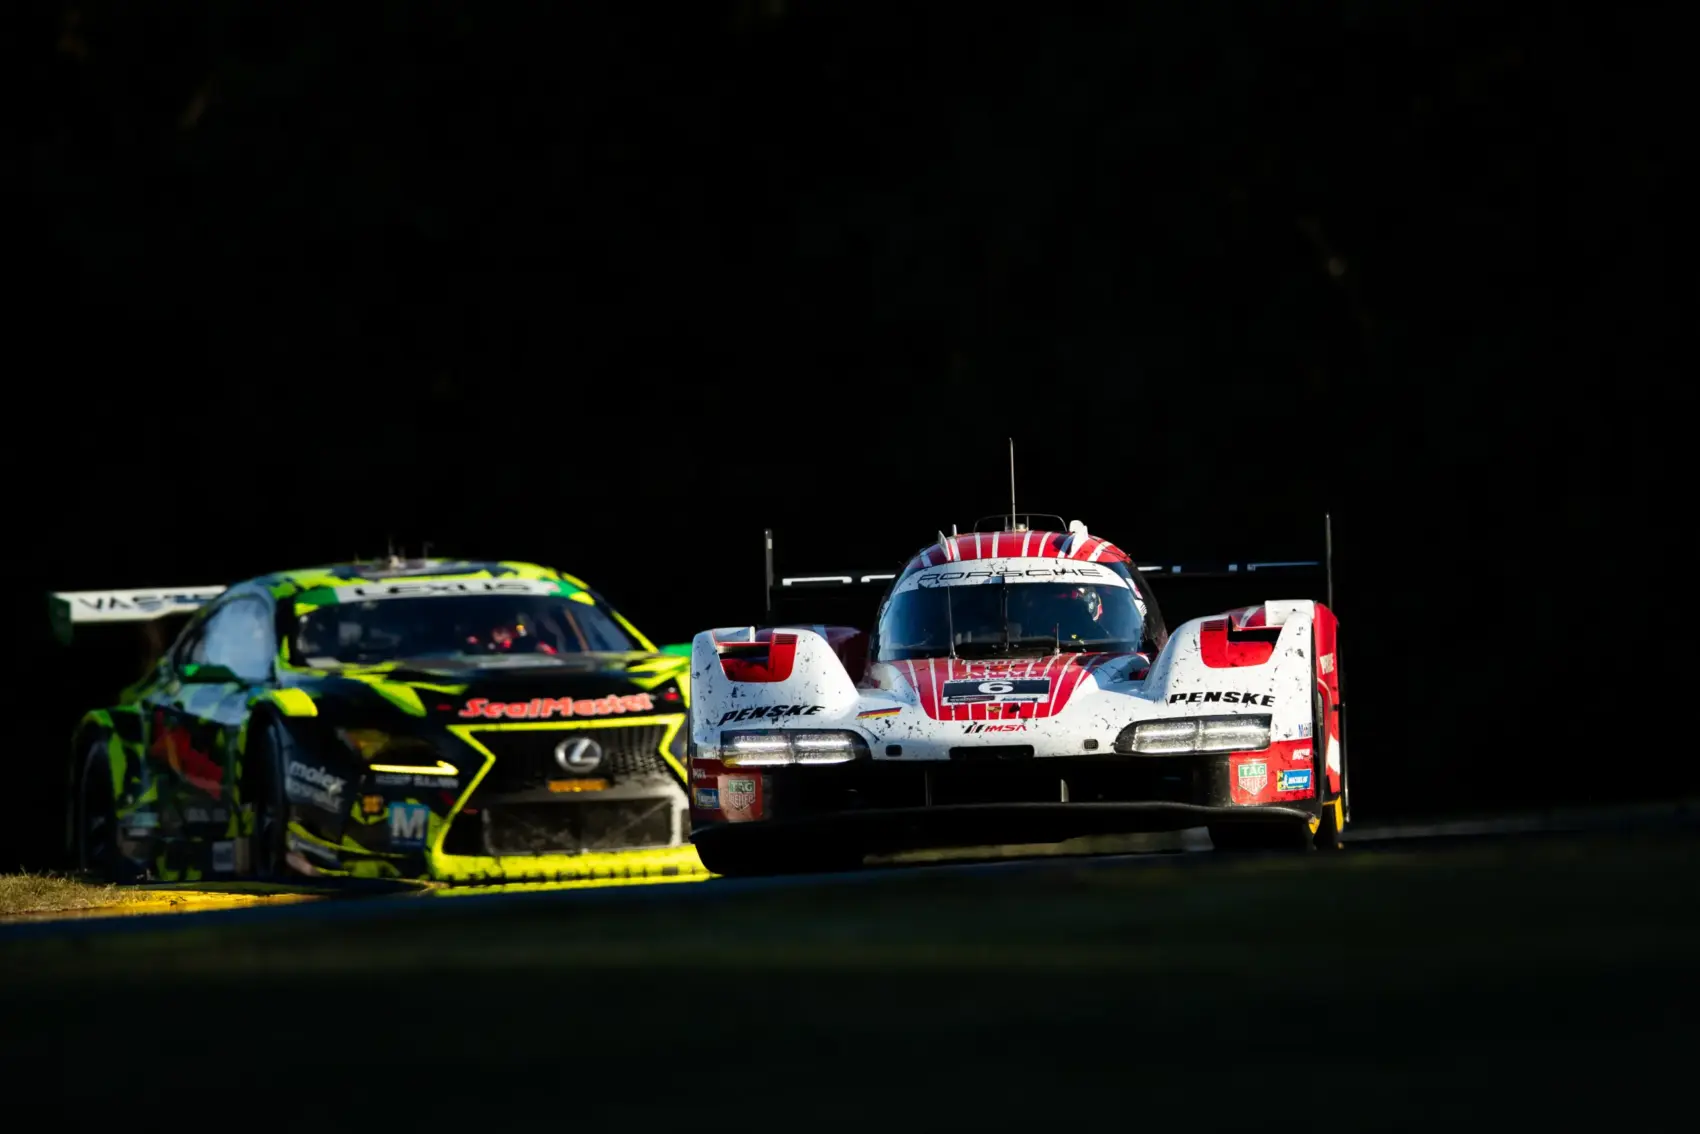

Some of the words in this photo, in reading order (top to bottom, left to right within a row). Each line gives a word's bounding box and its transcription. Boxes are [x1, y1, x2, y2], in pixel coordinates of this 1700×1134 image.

[918, 568, 1103, 586] PORSCHE
[978, 681, 1014, 695] 6
[458, 692, 654, 718] SealMaster
[1168, 690, 1275, 707] PENSKE
[717, 704, 826, 726] PENSKE
[1242, 765, 1265, 777] TAG
[730, 781, 753, 793] TAG
[391, 806, 425, 841] M
